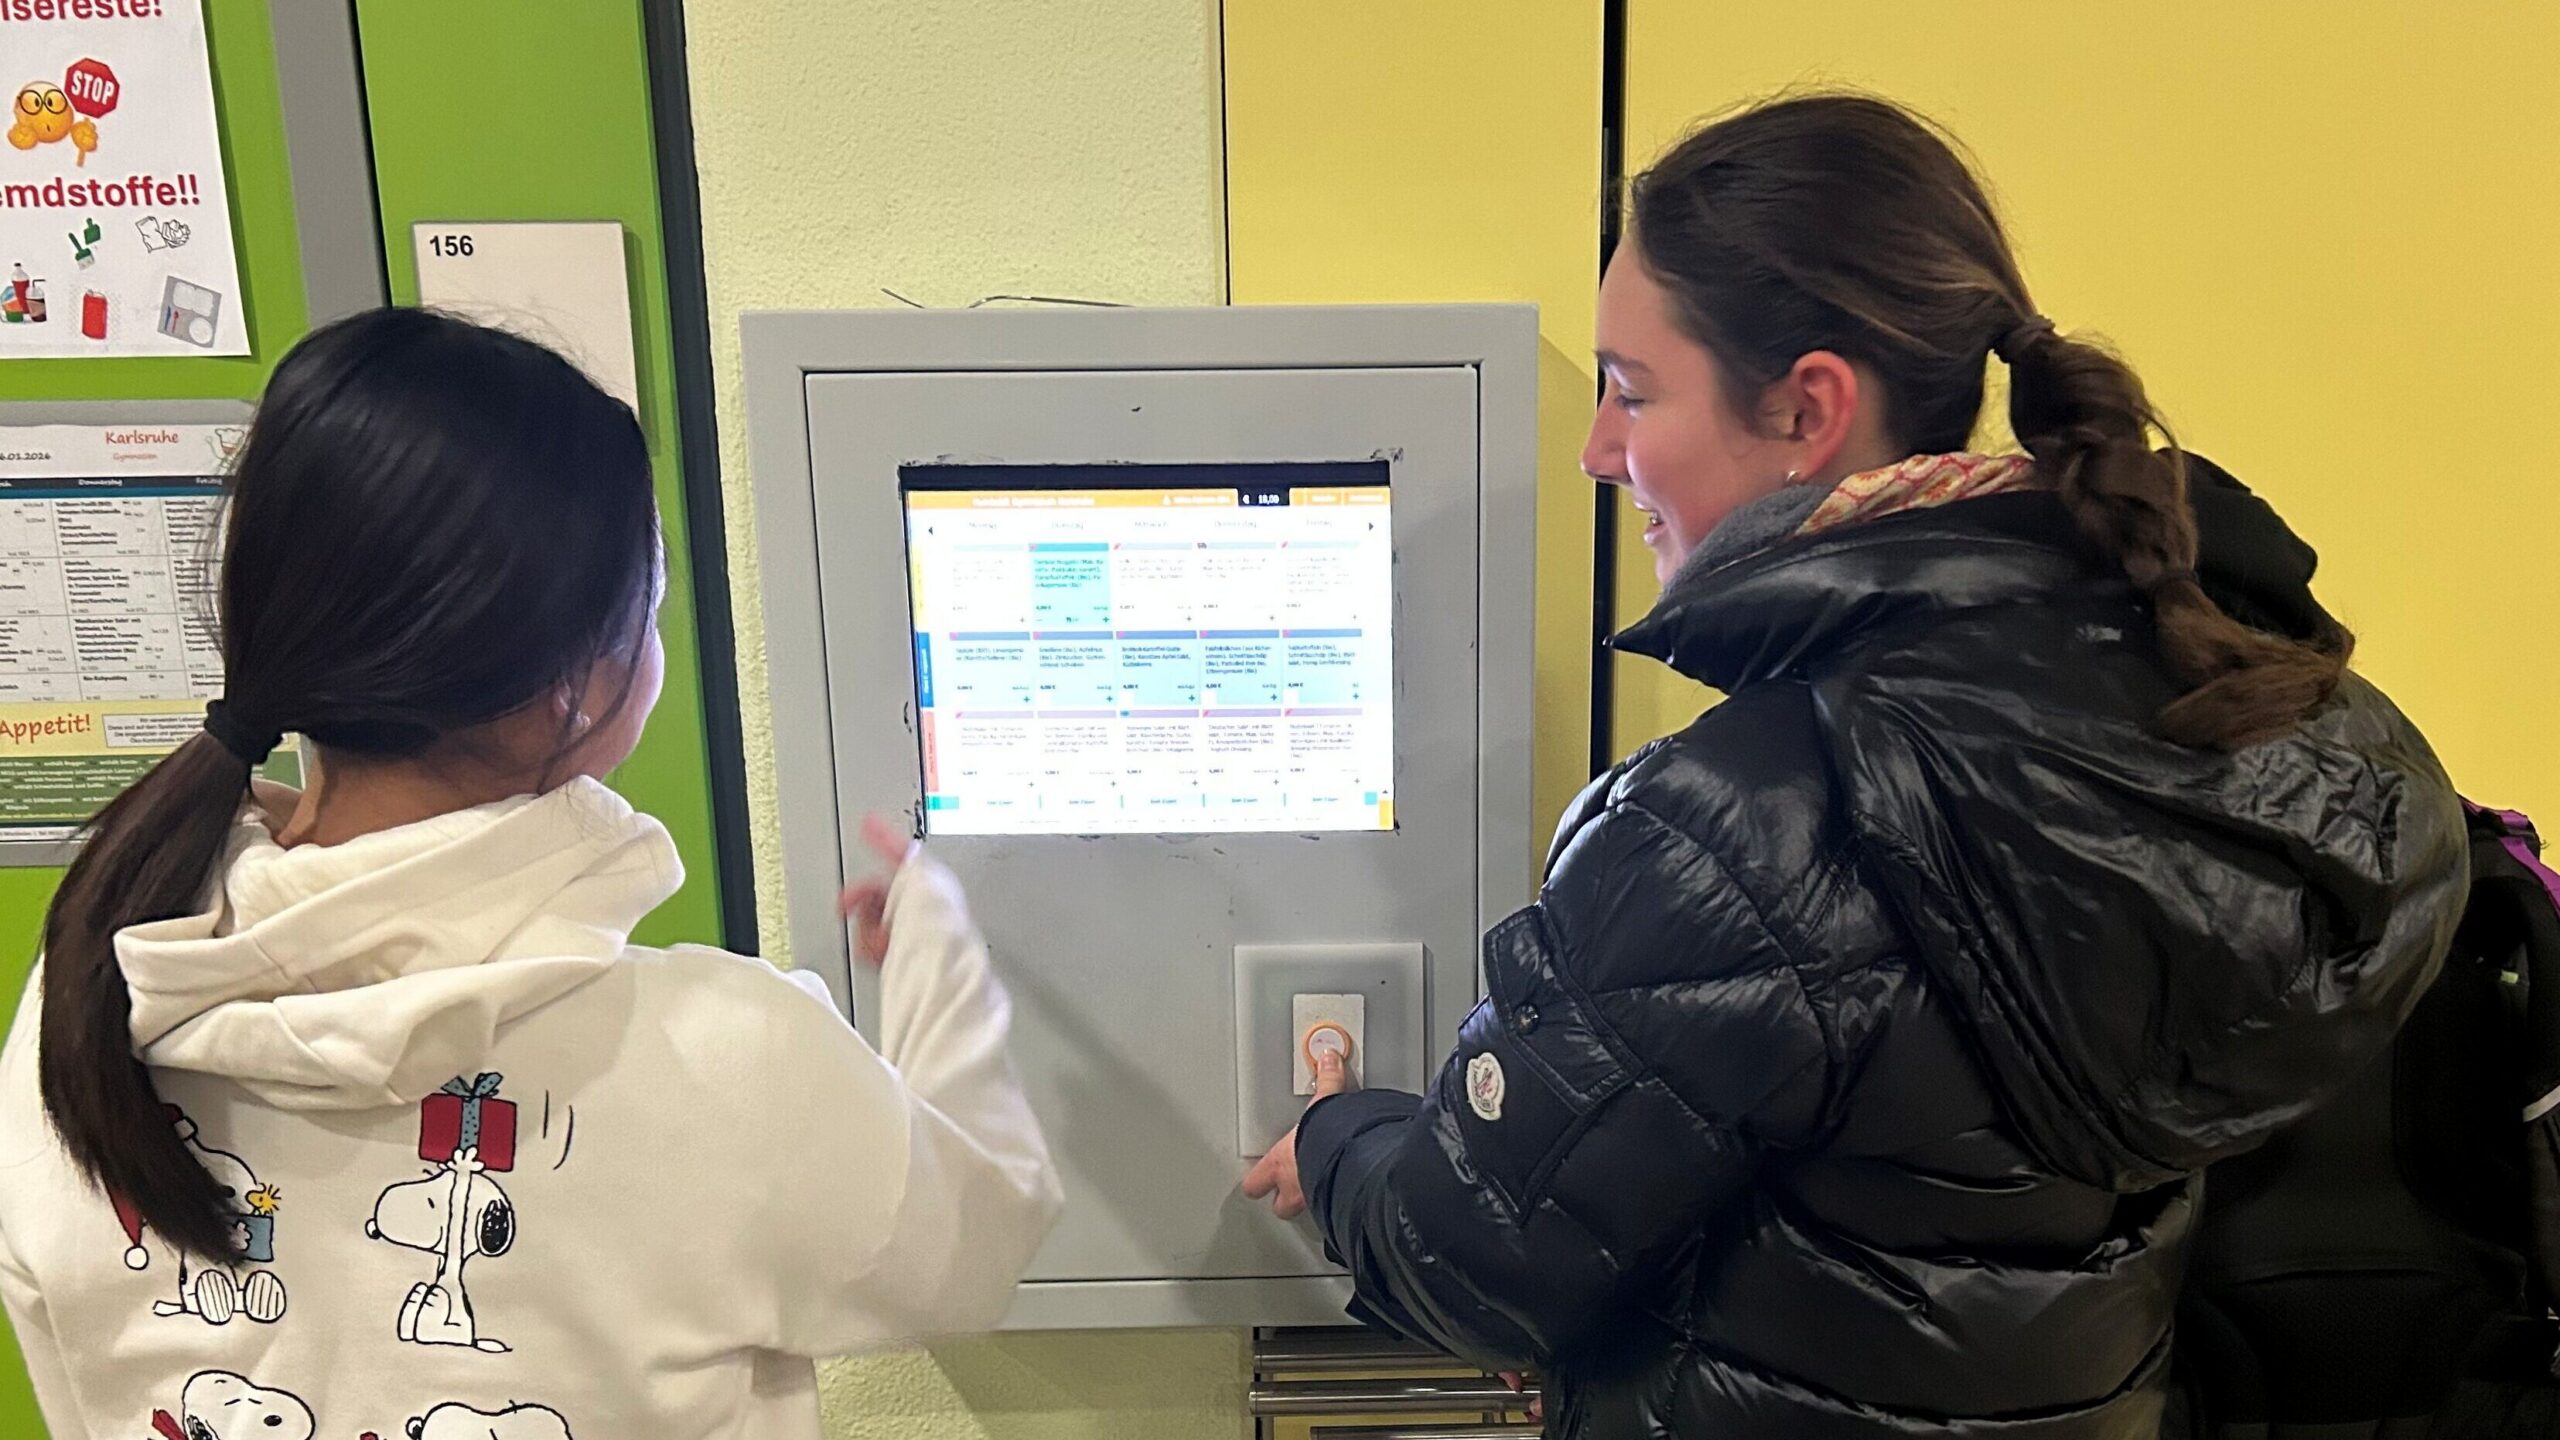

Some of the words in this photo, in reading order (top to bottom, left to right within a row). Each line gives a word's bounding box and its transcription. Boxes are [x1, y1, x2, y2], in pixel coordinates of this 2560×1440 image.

[71, 70, 115, 105] STOP
[0, 174, 200, 208] mdstoffe!!
[429, 235, 474, 257] 156
[105, 429, 179, 444] Karlsruhe
[0, 714, 91, 744] Appetit!
